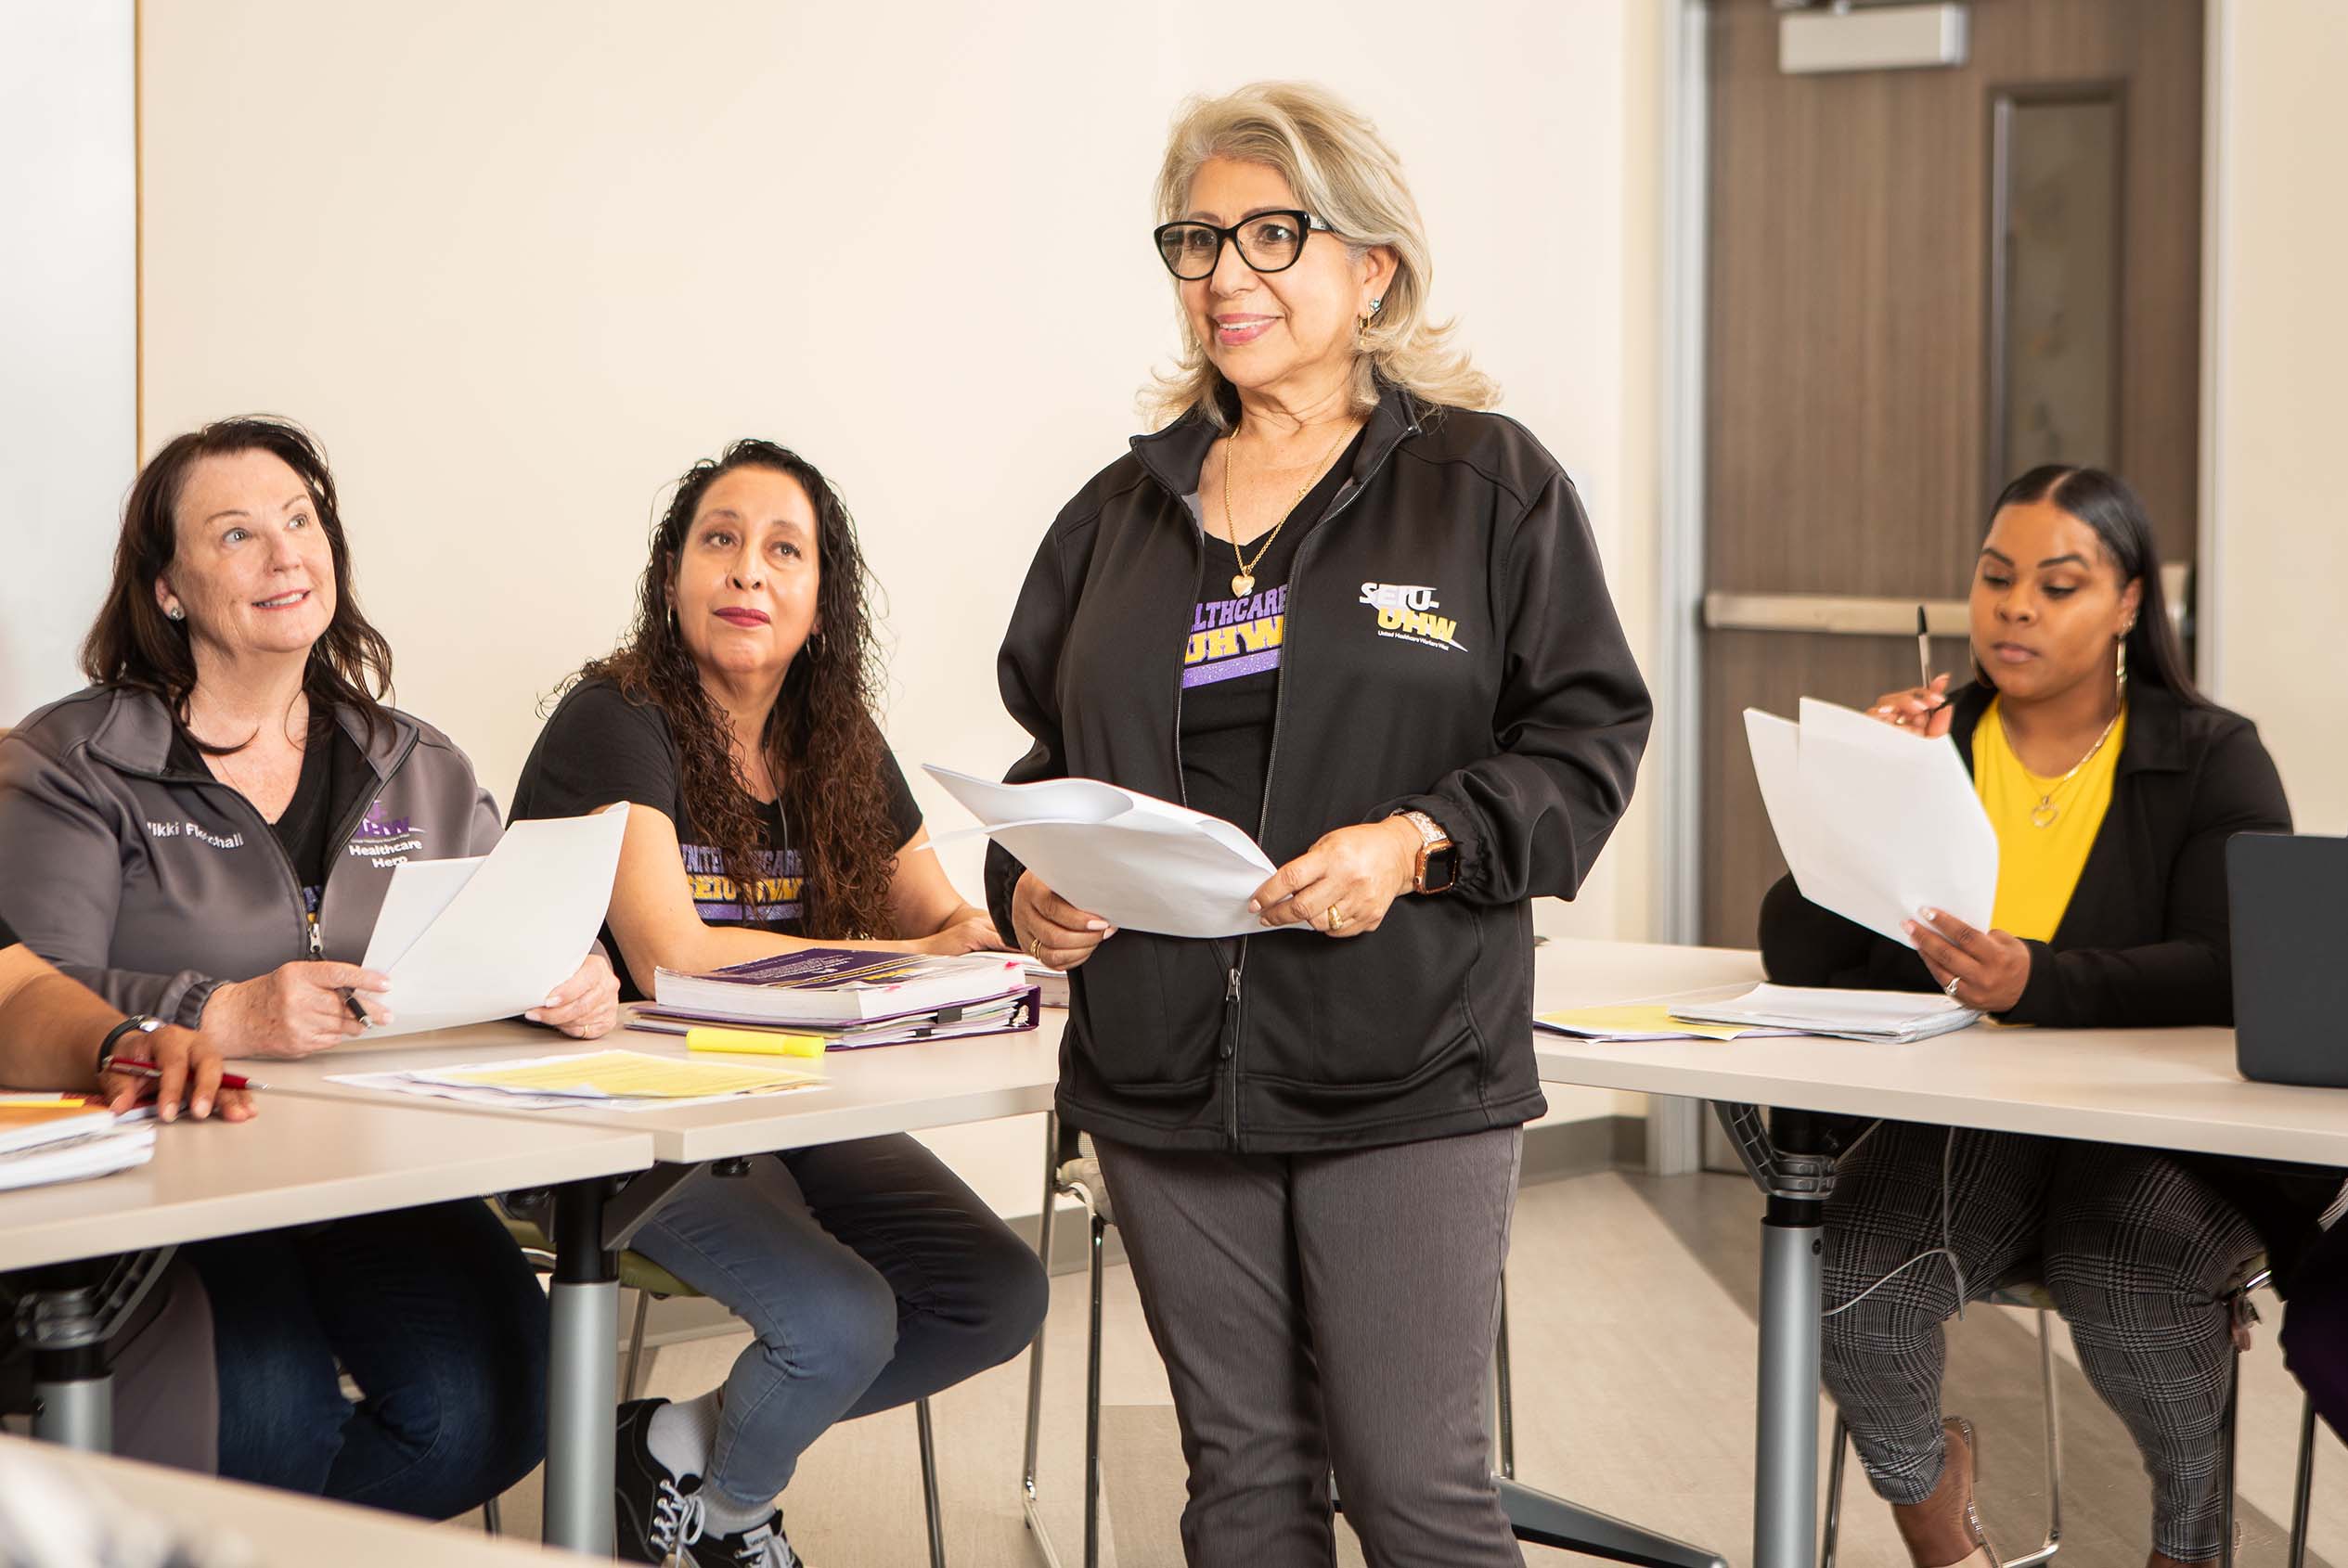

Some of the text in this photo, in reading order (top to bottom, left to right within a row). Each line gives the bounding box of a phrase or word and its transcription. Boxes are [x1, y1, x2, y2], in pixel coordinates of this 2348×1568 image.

[1377, 608, 1457, 642] UHW
[147, 821, 180, 837] ikki
[348, 840, 423, 856] Healthcare
